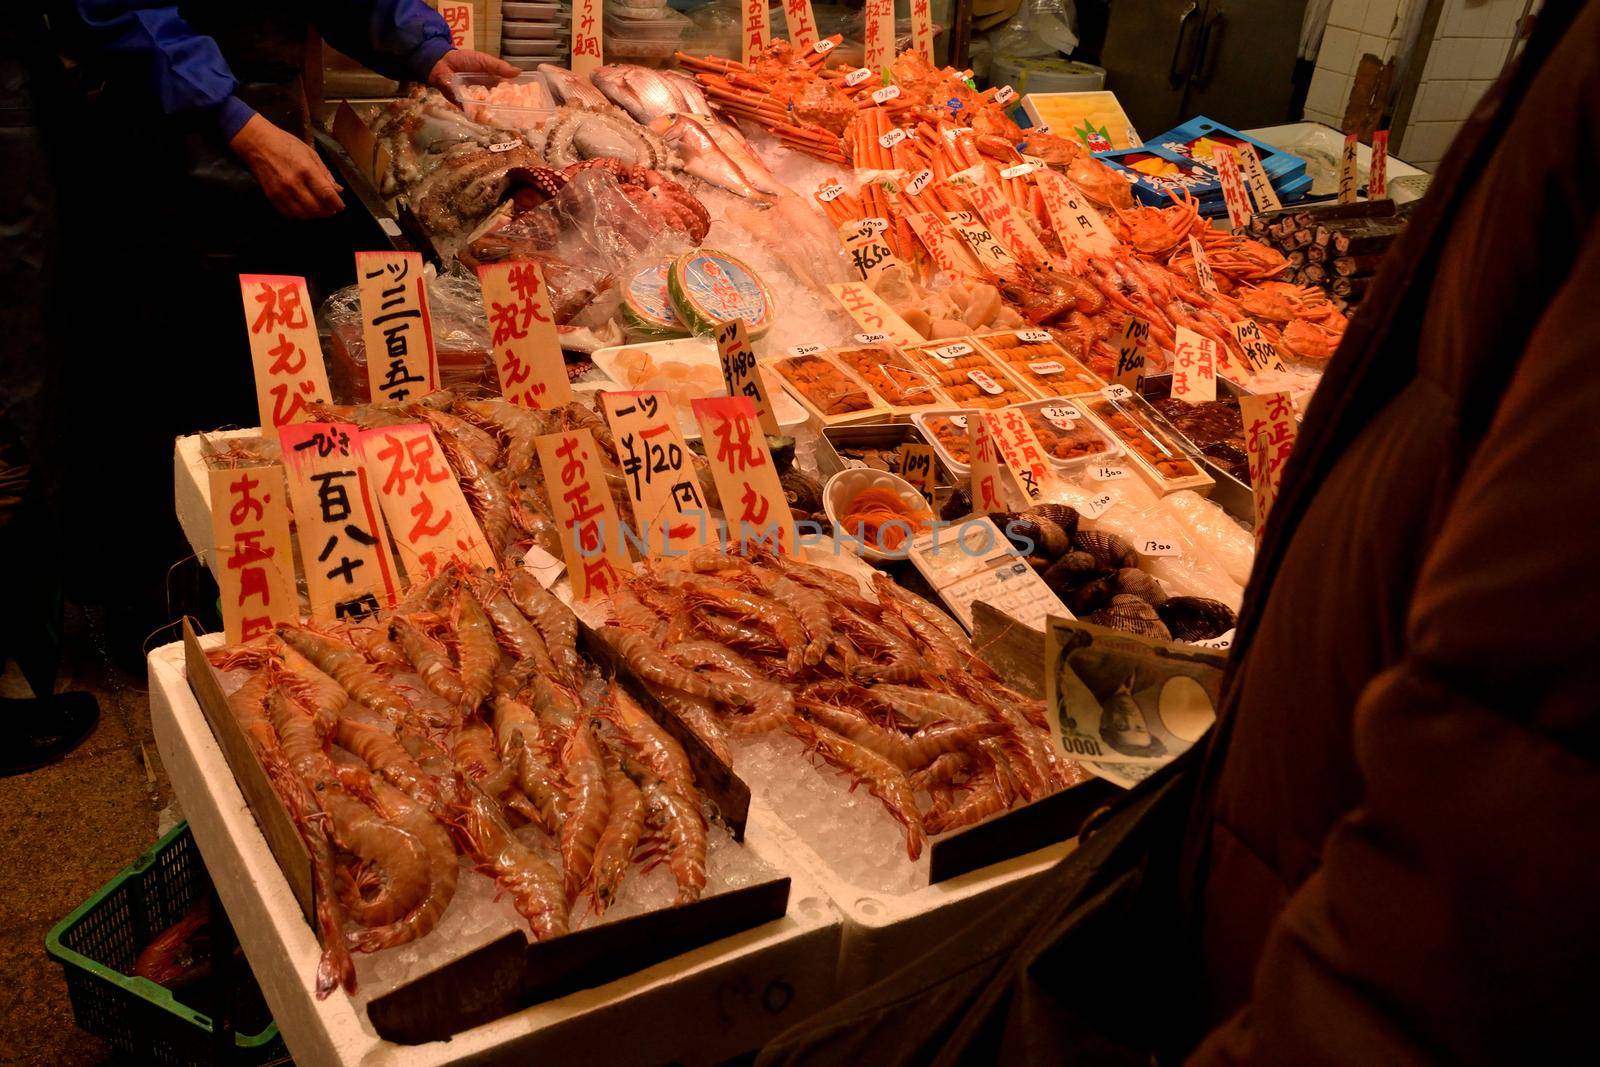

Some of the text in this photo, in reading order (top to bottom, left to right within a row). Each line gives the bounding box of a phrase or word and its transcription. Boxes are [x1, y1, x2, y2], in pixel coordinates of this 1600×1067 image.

[847, 227, 873, 242] 一ツ
[959, 226, 992, 255] ¥300
[366, 258, 408, 282] 一ツ
[851, 244, 891, 280] ¥650
[508, 263, 550, 329] 特大
[251, 281, 316, 428] 祝えび
[1117, 347, 1145, 377] ¥600
[1244, 342, 1276, 370] ¥800
[723, 350, 757, 397] ¥480
[614, 394, 658, 419] 一ツ
[621, 432, 683, 502] ¥120
[975, 420, 1001, 511] 赤貝
[1089, 495, 1110, 513] 1500
[556, 437, 621, 604] お正月用
[1144, 541, 1171, 552] 1300
[1062, 736, 1104, 757] 1000
